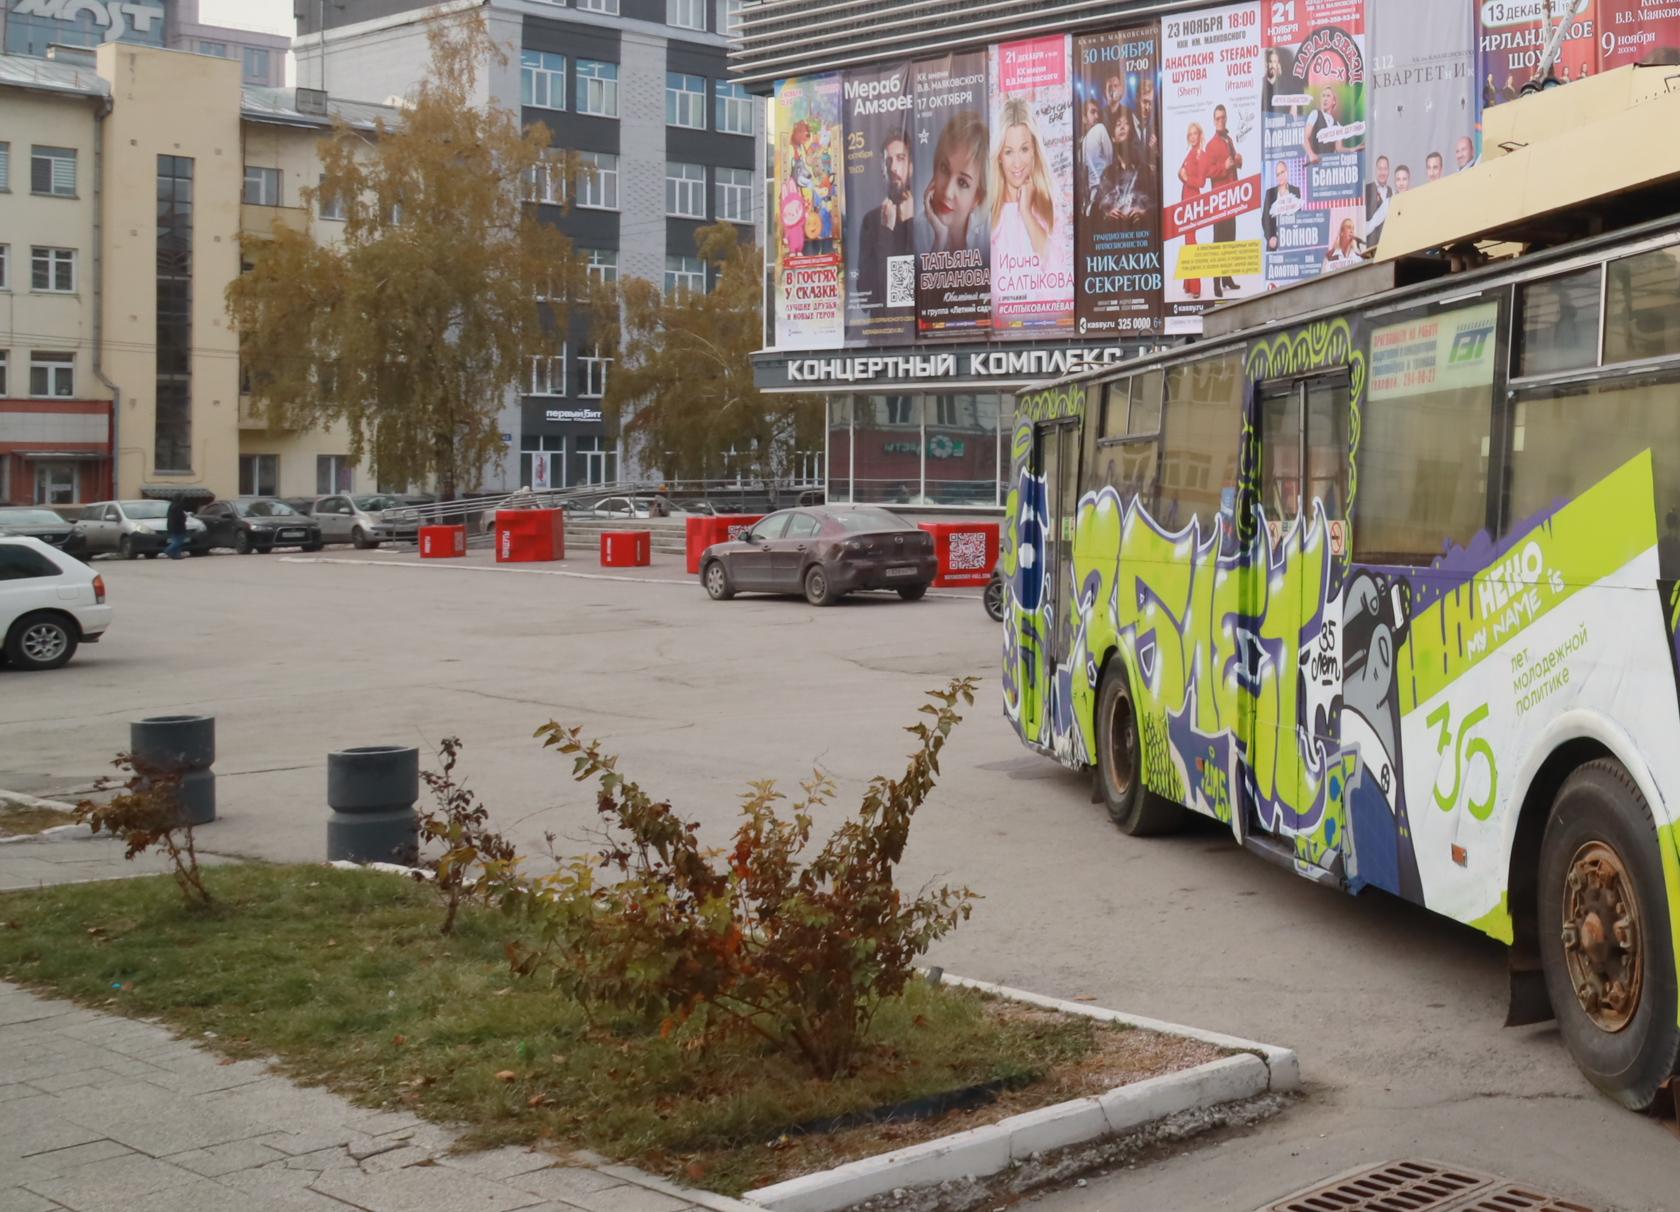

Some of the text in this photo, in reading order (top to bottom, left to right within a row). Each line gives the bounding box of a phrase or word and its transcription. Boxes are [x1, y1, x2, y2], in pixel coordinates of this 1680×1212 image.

[1272, 1, 1295, 23] 21
[1488, 4, 1504, 22] 13
[1505, 1, 1556, 21] ДЕКАБЯ
[1168, 11, 1256, 38] 23 НОЯБРЯ 18:00
[1268, 24, 1299, 36] НОЯБРЯ
[1082, 40, 1154, 64] 30 НОЯБРЯ
[1220, 45, 1259, 62] STEFANO
[1601, 31, 1656, 57] 9 ноября
[1005, 51, 1016, 64] 21
[1126, 58, 1149, 72] 17:00
[1165, 51, 1215, 70] АНАСТАСИЯ
[1172, 68, 1207, 83] ШУТОВА
[1227, 61, 1252, 77] VOICE
[1373, 65, 1445, 90] КВАРТЕТ
[844, 74, 901, 100] Мераб
[931, 74, 985, 90] МАЯКОВСКОГО
[1177, 85, 1202, 96] (Sherry)
[1225, 80, 1254, 92] (Италия)
[917, 91, 972, 110] 17 ОКТЯБРЯ
[848, 131, 865, 150] 25
[1173, 182, 1253, 226] САН-РЕМО
[920, 248, 983, 271] ТАТЬЯНА
[999, 253, 1040, 269] Ирина
[1086, 252, 1160, 272] НИКАКИХ
[786, 269, 837, 285] В ГОСТЯХ
[920, 268, 991, 290] БУЛАНОВА
[997, 272, 1074, 291] САЛТЫКОВА
[1084, 273, 1162, 294] СЕКРЕТОВ
[785, 287, 792, 300] У
[927, 307, 949, 317] группа
[1118, 318, 1132, 329] 325
[1133, 317, 1151, 329] 0000
[787, 353, 956, 381] КОНЦЕРТНЫЙ
[970, 347, 1123, 376] КОМПЛЕКС
[1493, 588, 1542, 641] NAME
[1319, 619, 1336, 652] 35
[1511, 647, 1528, 674] лет
[1513, 621, 1588, 694] молодежной
[1515, 666, 1570, 716] политике
[1426, 701, 1498, 821] 35
